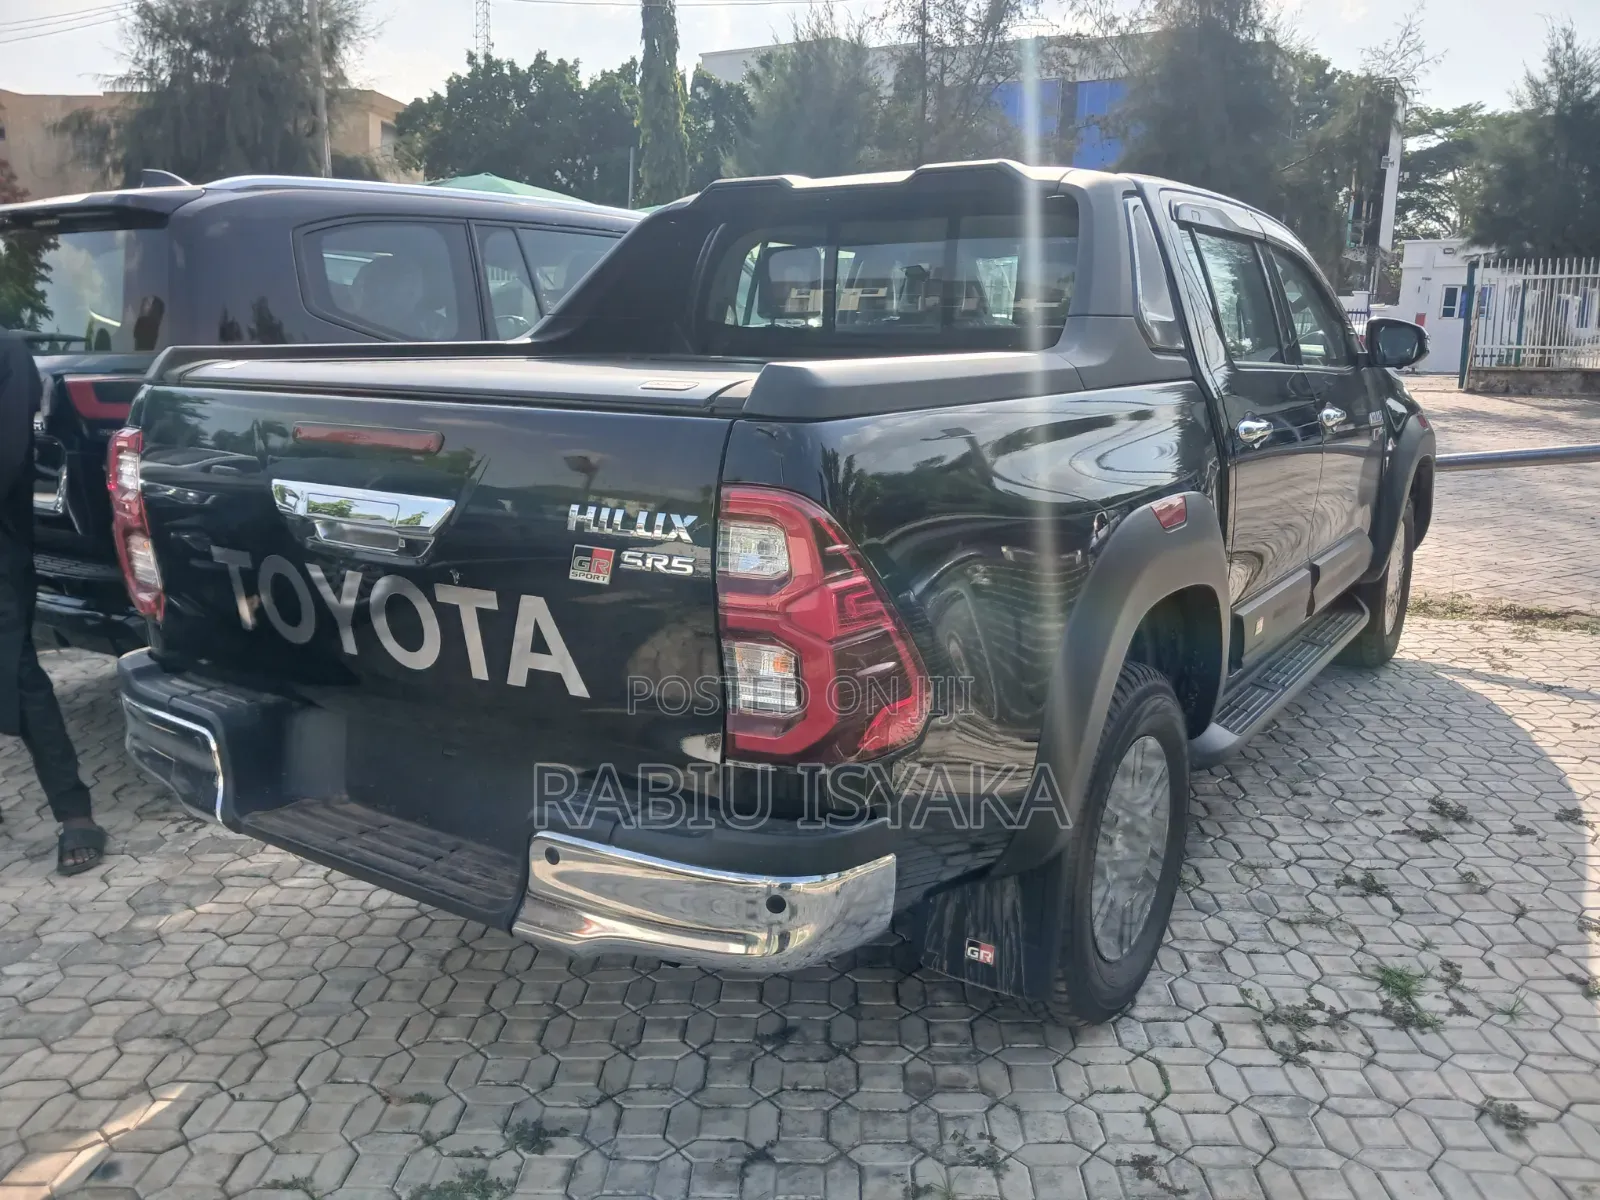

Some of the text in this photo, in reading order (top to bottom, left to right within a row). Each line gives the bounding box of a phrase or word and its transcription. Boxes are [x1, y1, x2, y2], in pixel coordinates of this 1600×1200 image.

[567, 504, 698, 543] HILUX
[573, 555, 610, 575] GR
[619, 550, 696, 576] SR5
[570, 571, 608, 582] SPORT
[211, 545, 591, 699] TOYOTA
[967, 946, 993, 963] GR
